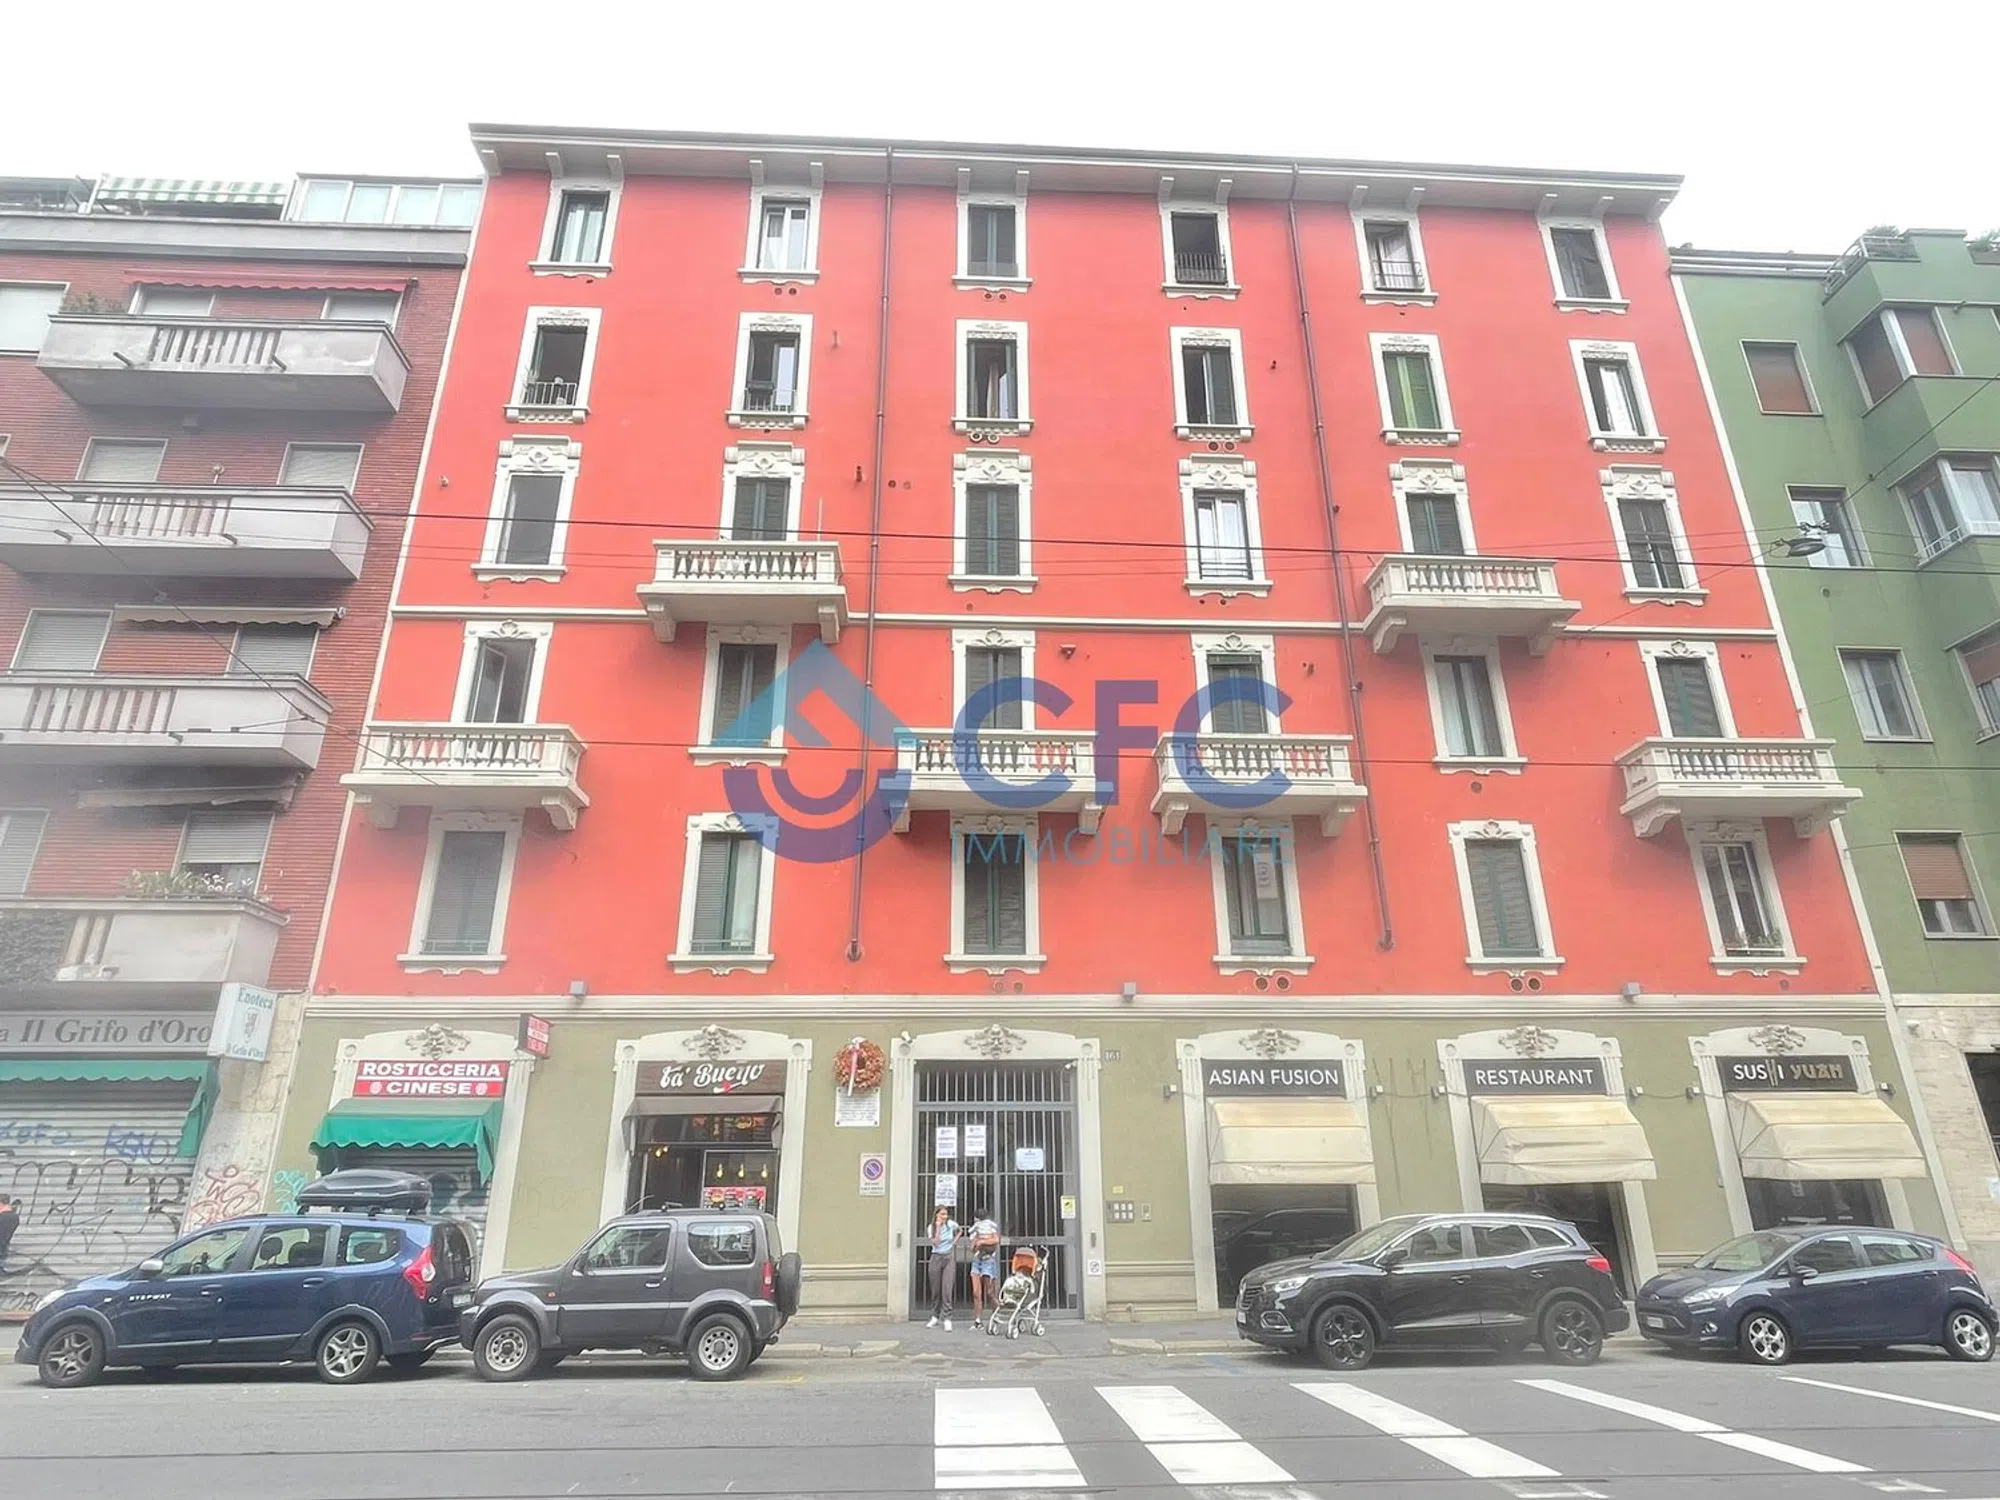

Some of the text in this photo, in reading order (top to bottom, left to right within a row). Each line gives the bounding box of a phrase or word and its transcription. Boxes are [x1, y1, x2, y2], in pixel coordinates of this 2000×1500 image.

[238, 986, 274, 1010] Enoteca
[20, 1019, 45, 1043] Il
[54, 1019, 129, 1044] Grifo
[138, 1019, 212, 1044] d'Oro
[362, 1062, 501, 1077] ROSTICCERIA
[1209, 1069, 1339, 1085] ASIAN FUSION
[1475, 1069, 1594, 1085] RESTAURANT
[385, 1081, 472, 1095] CINESE
[129, 1293, 172, 1301] STEPWAY
